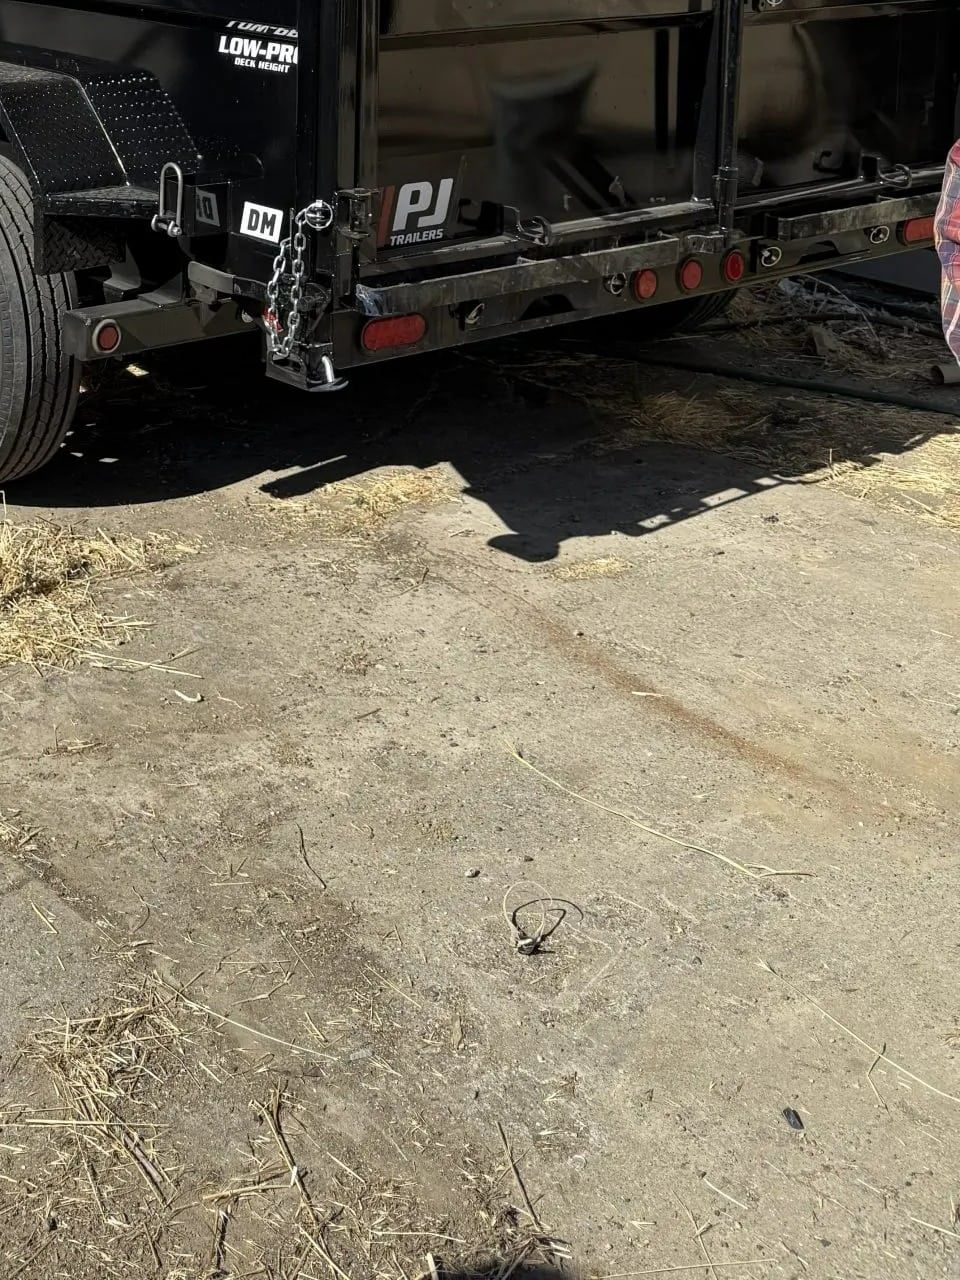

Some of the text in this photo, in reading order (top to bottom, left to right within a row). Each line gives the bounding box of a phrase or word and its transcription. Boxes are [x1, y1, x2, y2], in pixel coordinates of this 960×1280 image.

[234, 57, 291, 74] DECK HEIGHT
[392, 177, 454, 232] PJ
[247, 208, 278, 237] DM
[390, 228, 444, 246] TRAILERS
